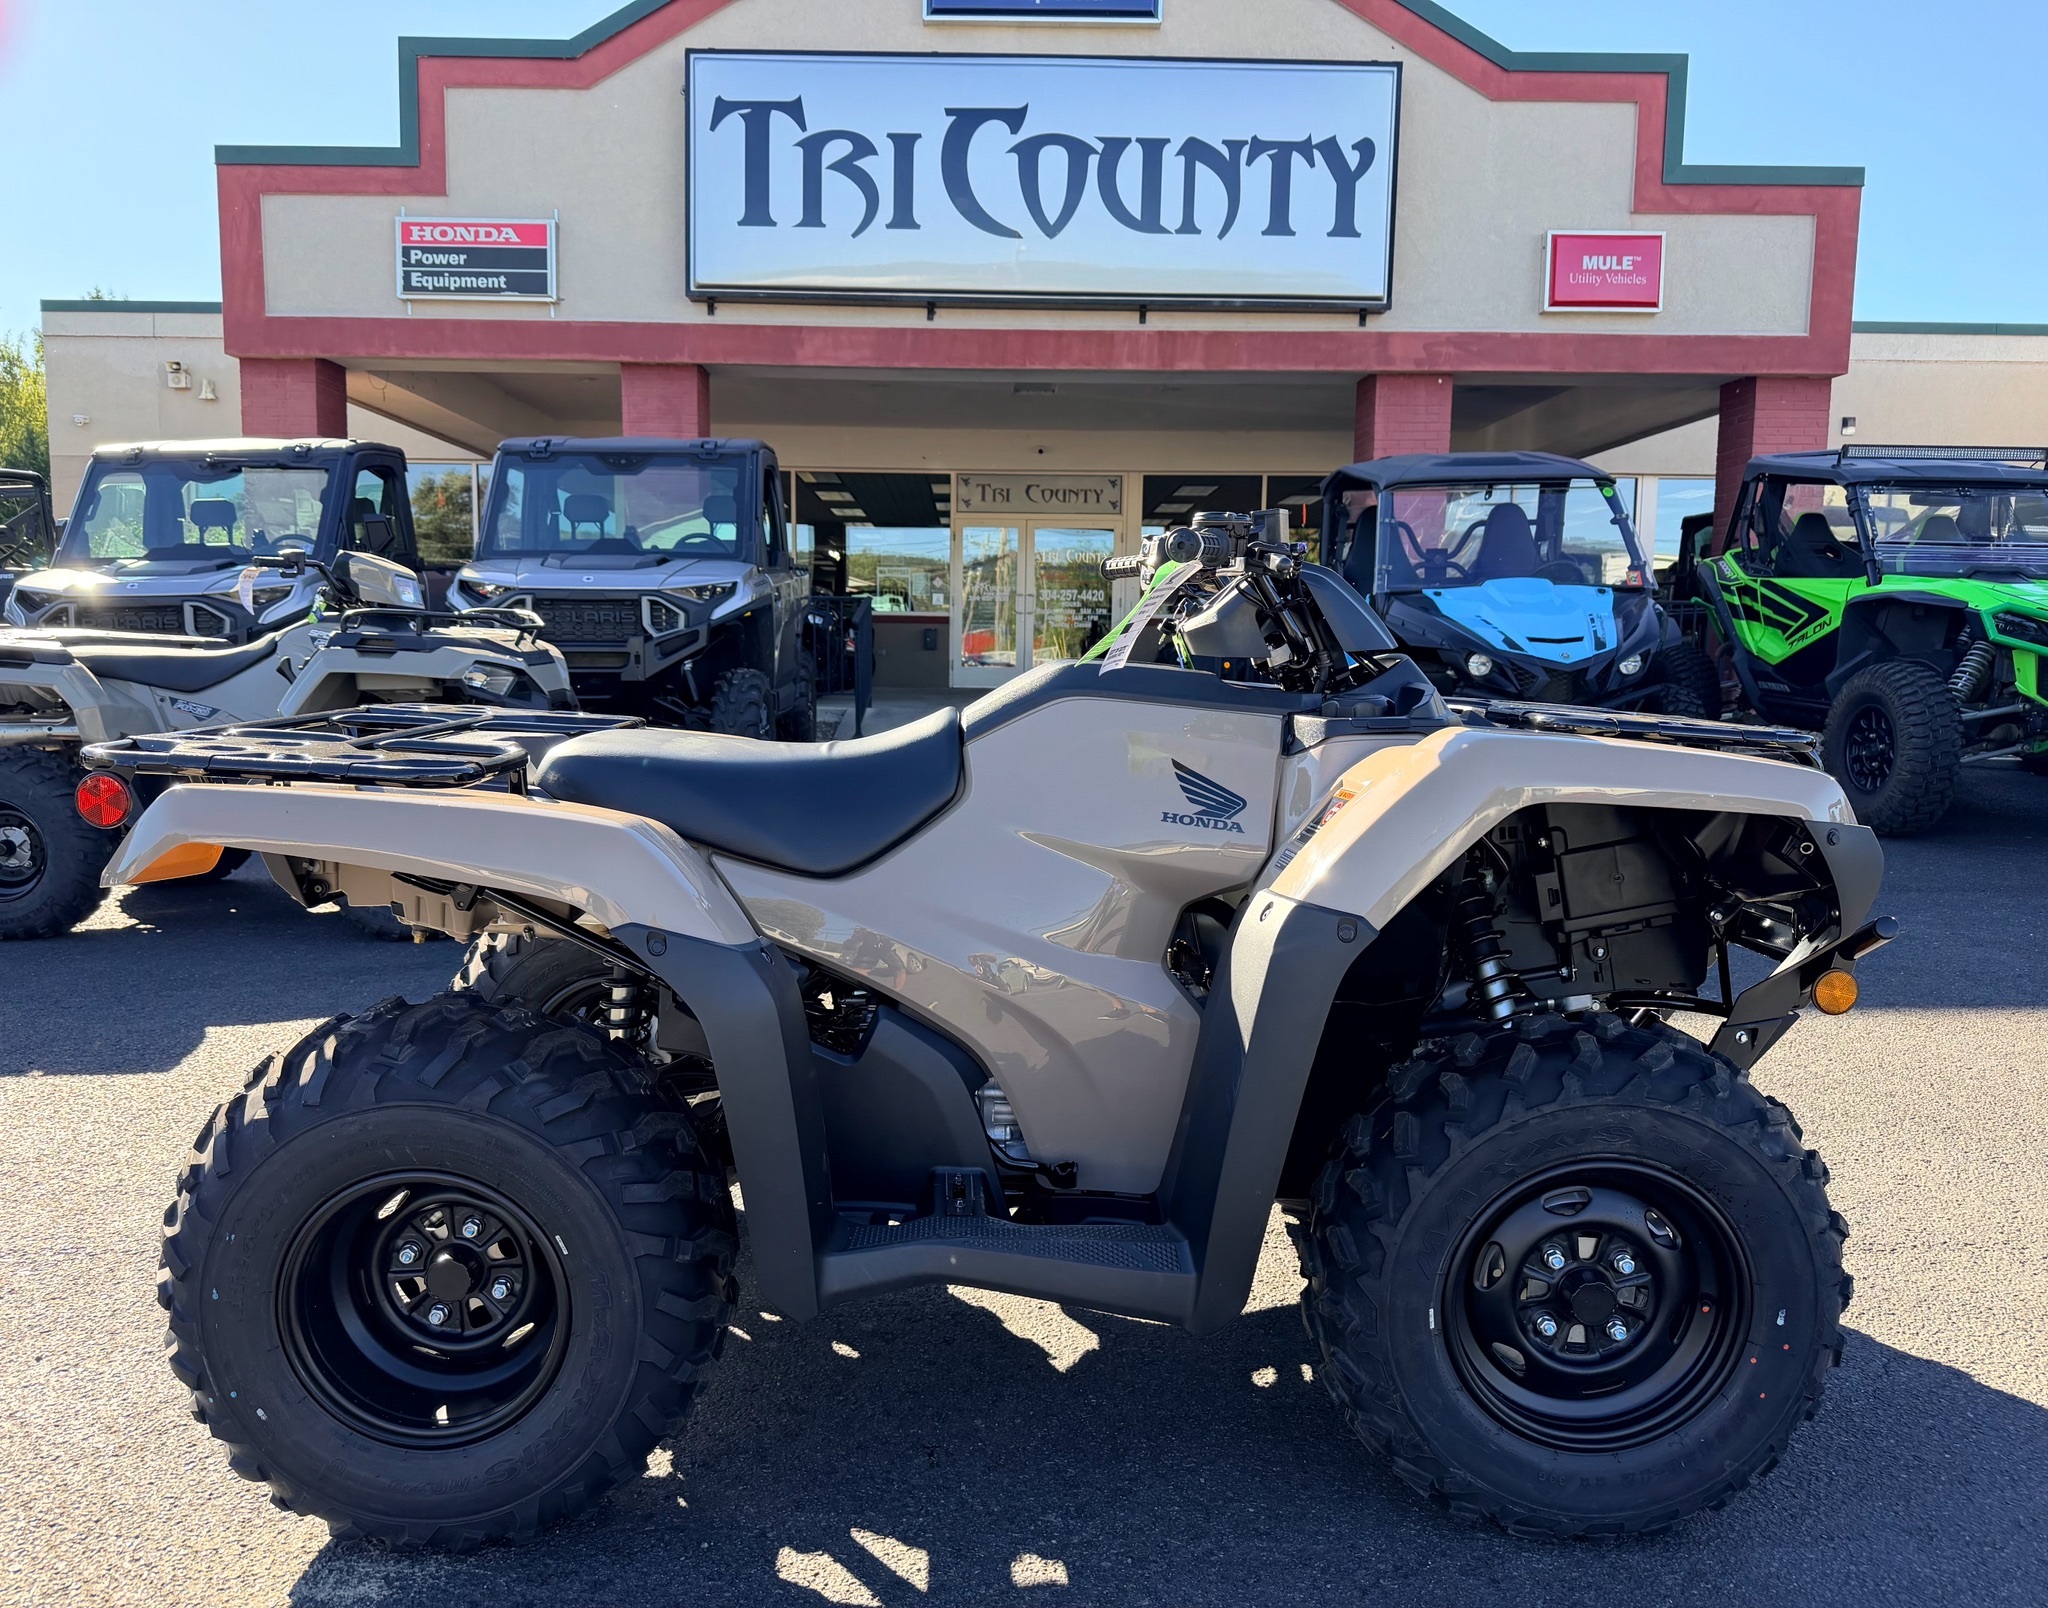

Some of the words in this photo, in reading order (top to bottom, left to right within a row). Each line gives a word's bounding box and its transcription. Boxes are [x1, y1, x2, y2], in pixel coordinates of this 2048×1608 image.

[709, 94, 922, 239] TRI
[941, 102, 1376, 241] COUNTY
[409, 226, 521, 243] HONDA
[410, 249, 467, 265] Power
[411, 272, 507, 290] Equipment
[1569, 273, 1602, 286] Utility
[1606, 273, 1647, 285] Vehicles
[976, 483, 1011, 503] TRI
[1025, 484, 1104, 504] COUNTY
[1039, 589, 1104, 602] 304-257-4420
[82, 614, 179, 630] POLARIS
[540, 611, 636, 622] POLARIS
[1788, 616, 1833, 650] TALON
[1160, 811, 1245, 834] HONDA
